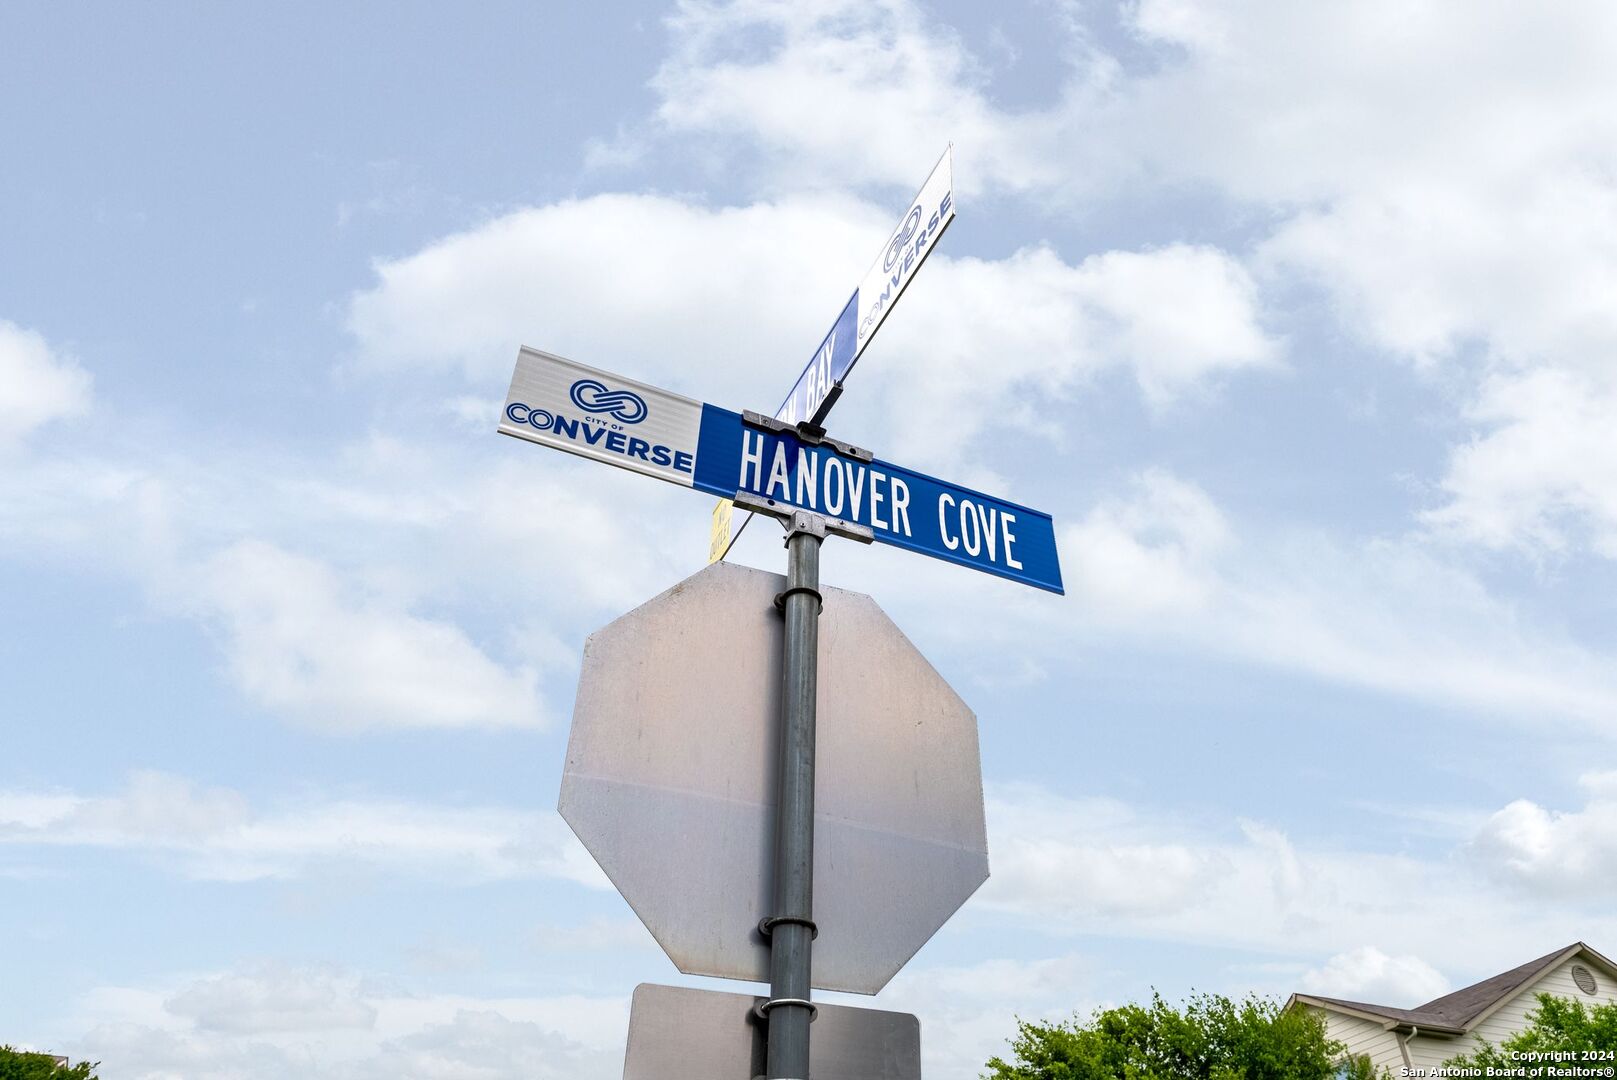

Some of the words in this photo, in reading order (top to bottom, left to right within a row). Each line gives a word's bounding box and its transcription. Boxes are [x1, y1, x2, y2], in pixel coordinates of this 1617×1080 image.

[858, 190, 952, 340] CONVERSE
[585, 416, 607, 426] CITY
[806, 332, 836, 422] BAY
[506, 402, 693, 473] CONVERSE
[739, 430, 911, 537] HANOVER
[939, 493, 1023, 570] COVE
